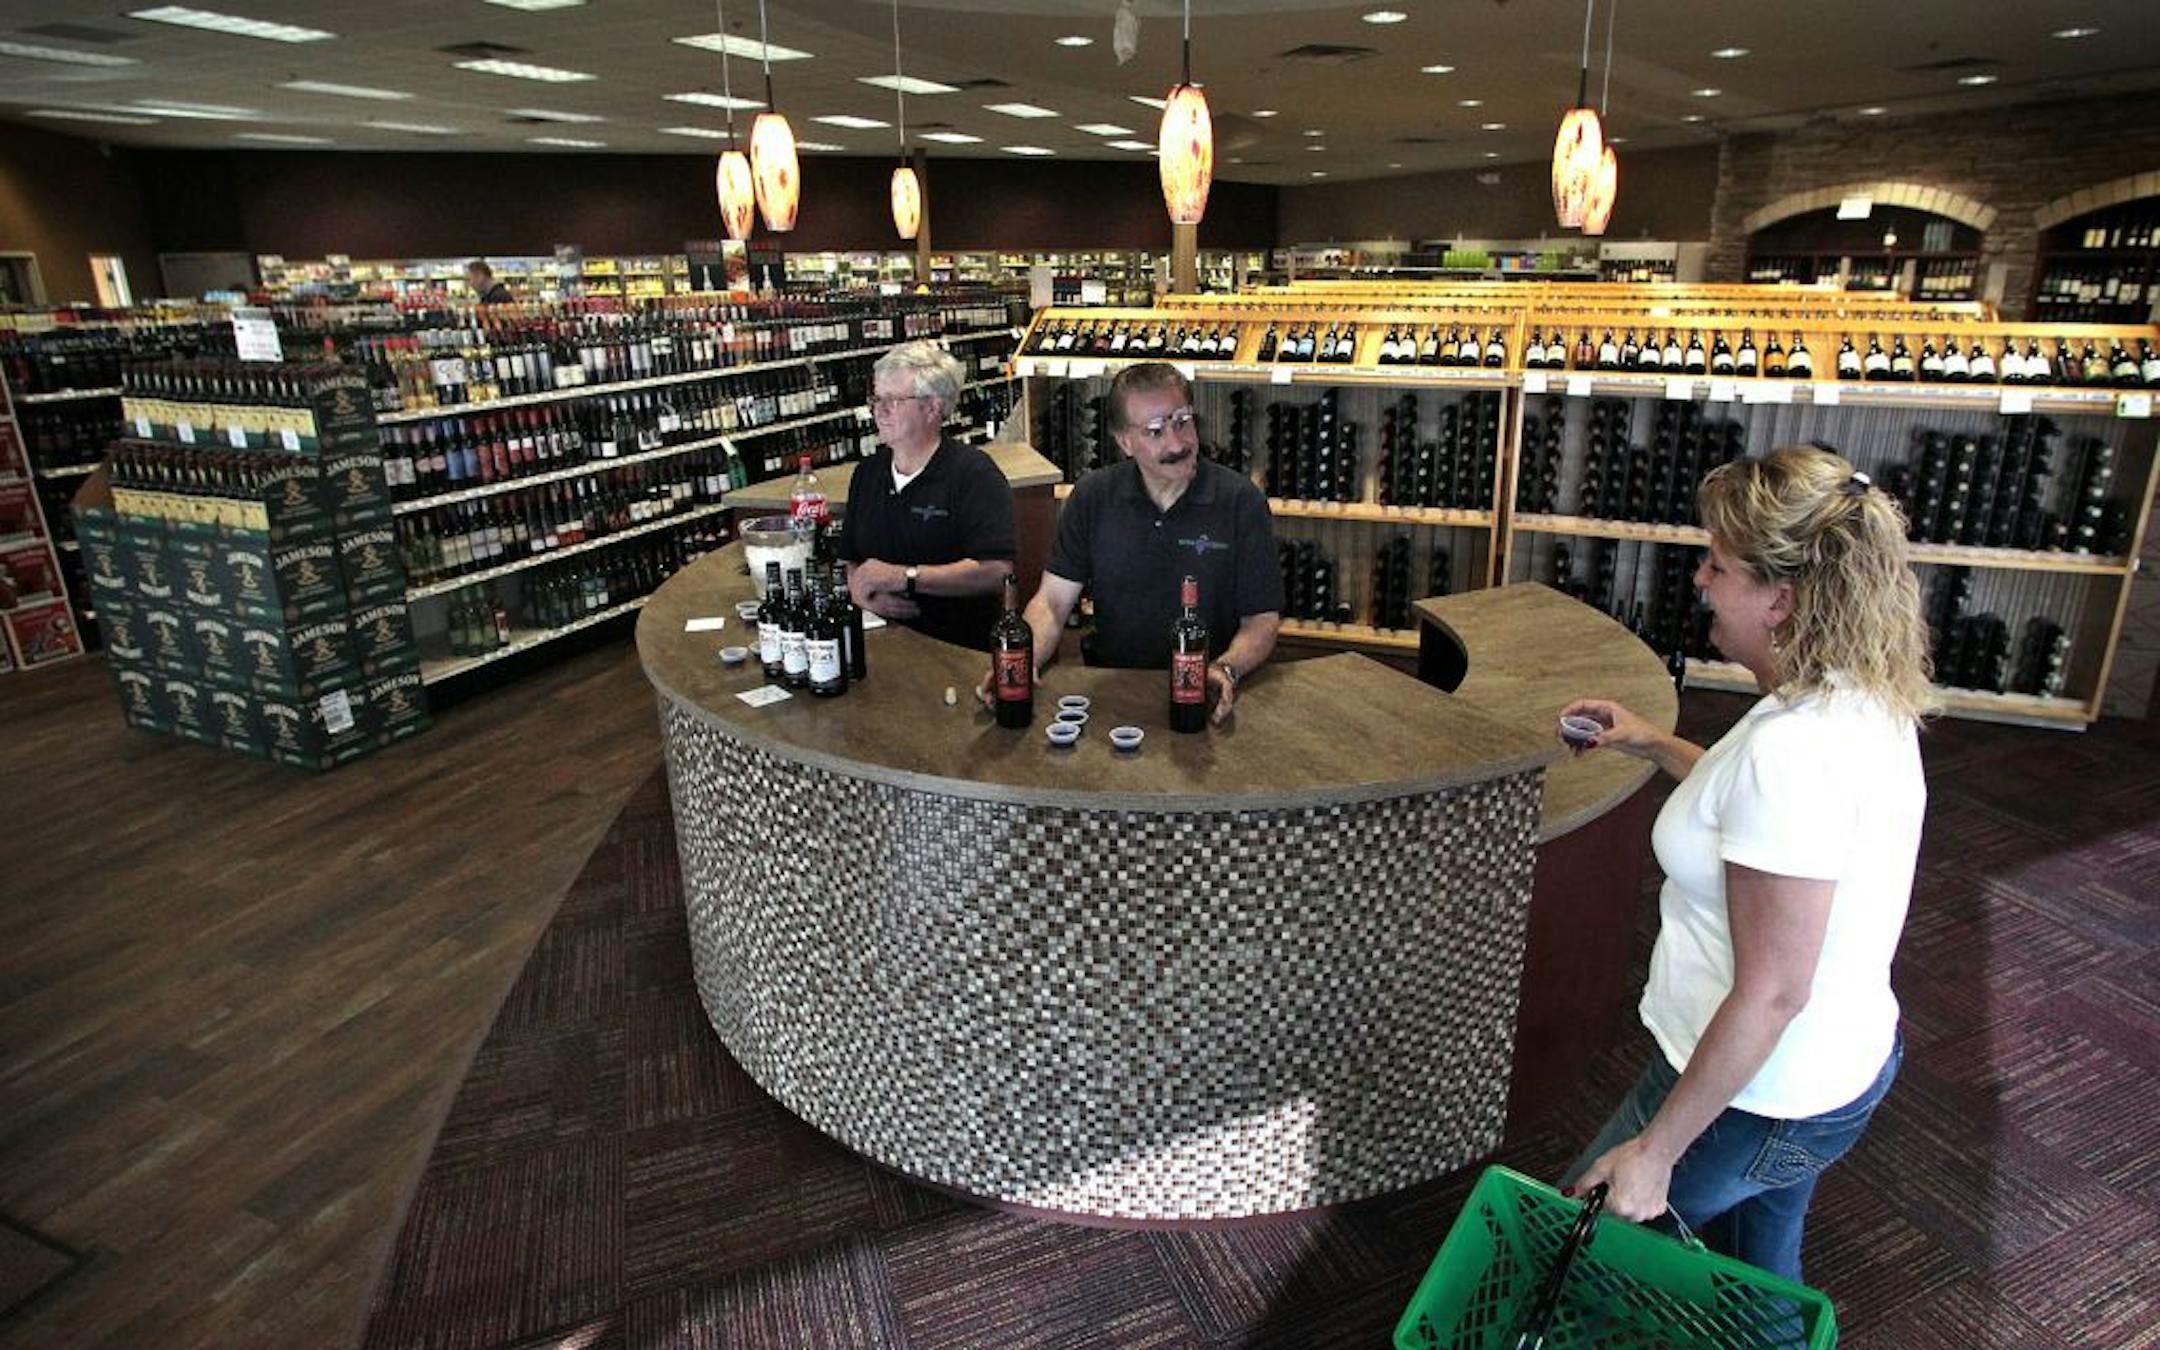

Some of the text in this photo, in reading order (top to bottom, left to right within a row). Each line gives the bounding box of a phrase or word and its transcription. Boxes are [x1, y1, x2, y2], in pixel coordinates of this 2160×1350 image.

[326, 455, 381, 477] JAMESON
[341, 531, 394, 554] JAMESON
[275, 544, 333, 571] JAMESON
[355, 603, 407, 629] JAMESON
[291, 622, 347, 648] JAMESON
[369, 674, 421, 701] JAMESON
